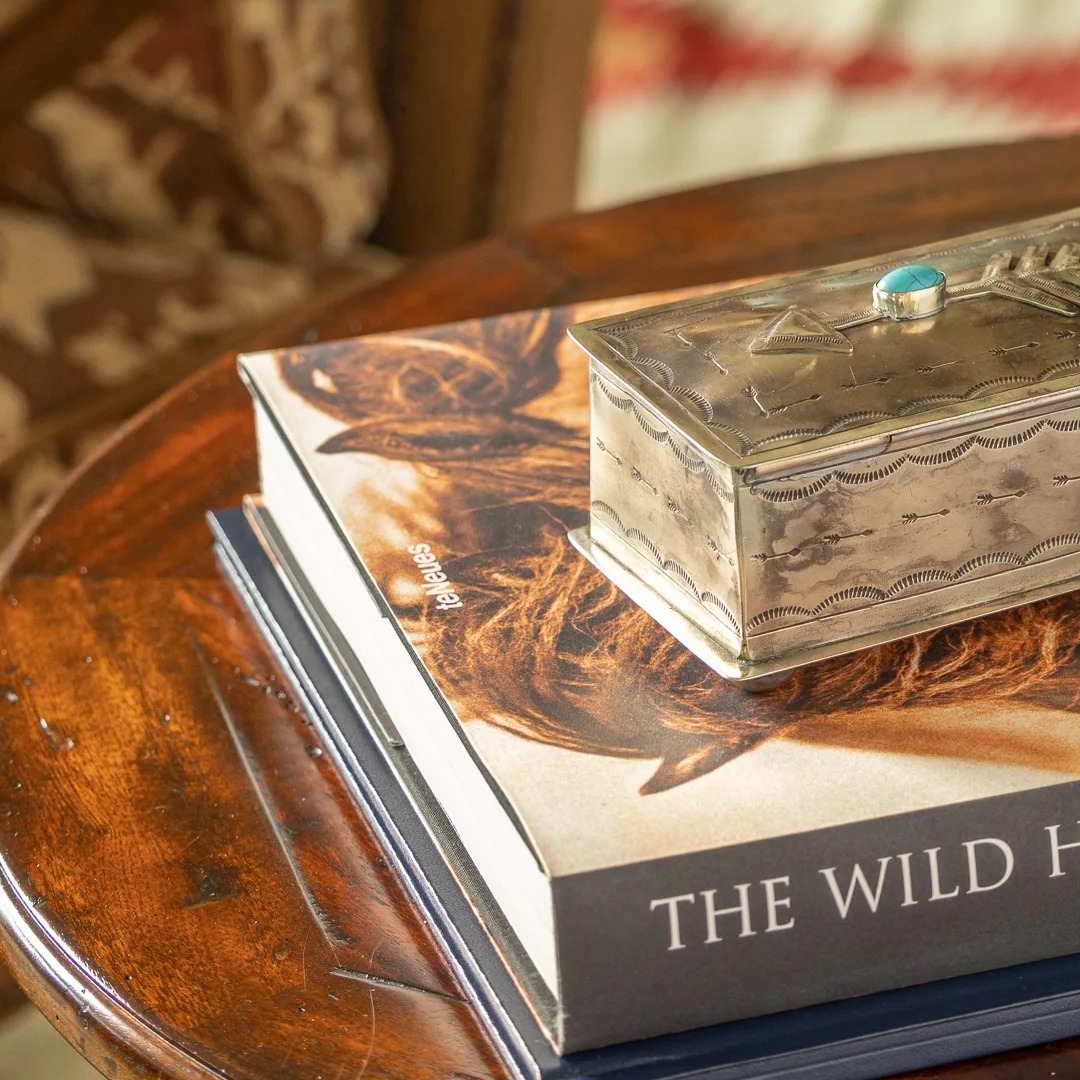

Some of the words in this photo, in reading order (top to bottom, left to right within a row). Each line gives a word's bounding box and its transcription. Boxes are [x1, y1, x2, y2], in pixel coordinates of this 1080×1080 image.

[407, 543, 463, 610] teNeues
[649, 875, 796, 951] THE
[818, 837, 1015, 919] WILD
